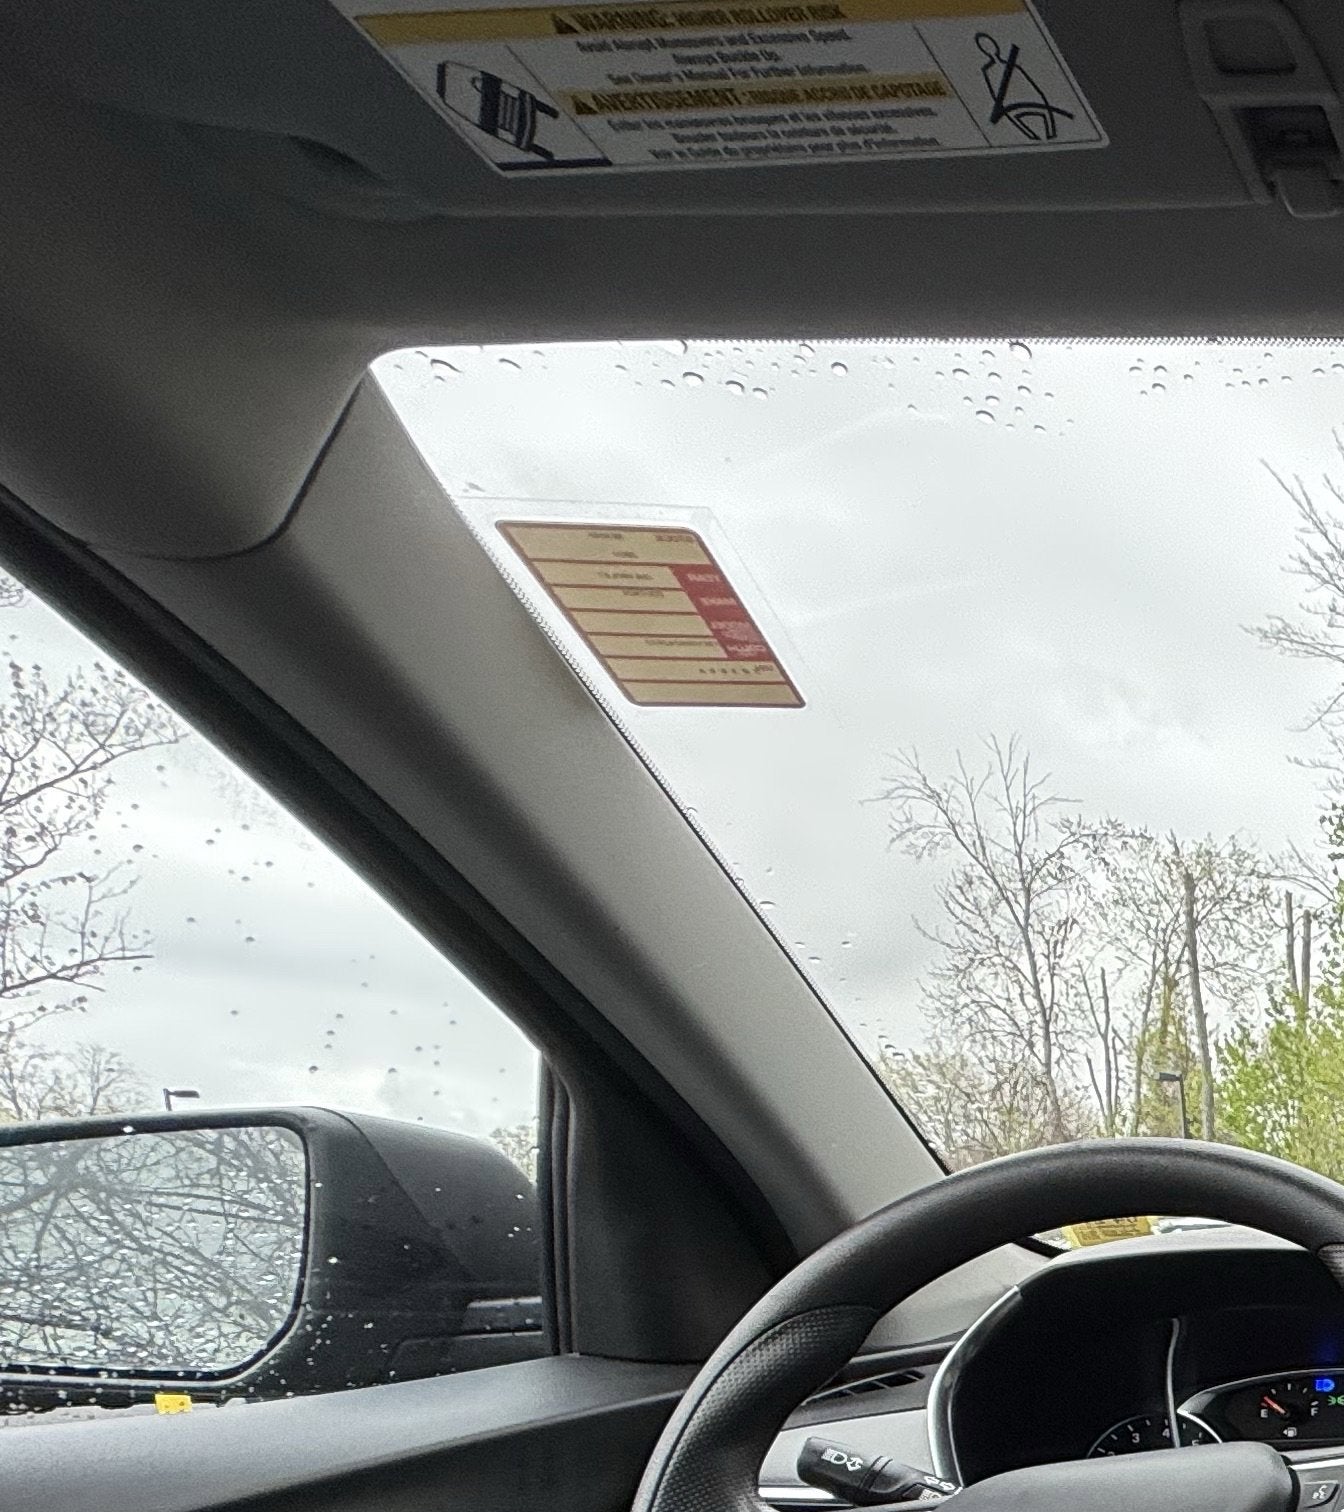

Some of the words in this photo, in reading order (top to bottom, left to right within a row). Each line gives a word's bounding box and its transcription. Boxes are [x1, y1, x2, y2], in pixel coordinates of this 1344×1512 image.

[1261, 1409, 1268, 1418] E
[1311, 1407, 1318, 1416] F
[1162, 1428, 1171, 1438] 4
[1132, 1433, 1140, 1443] 3
